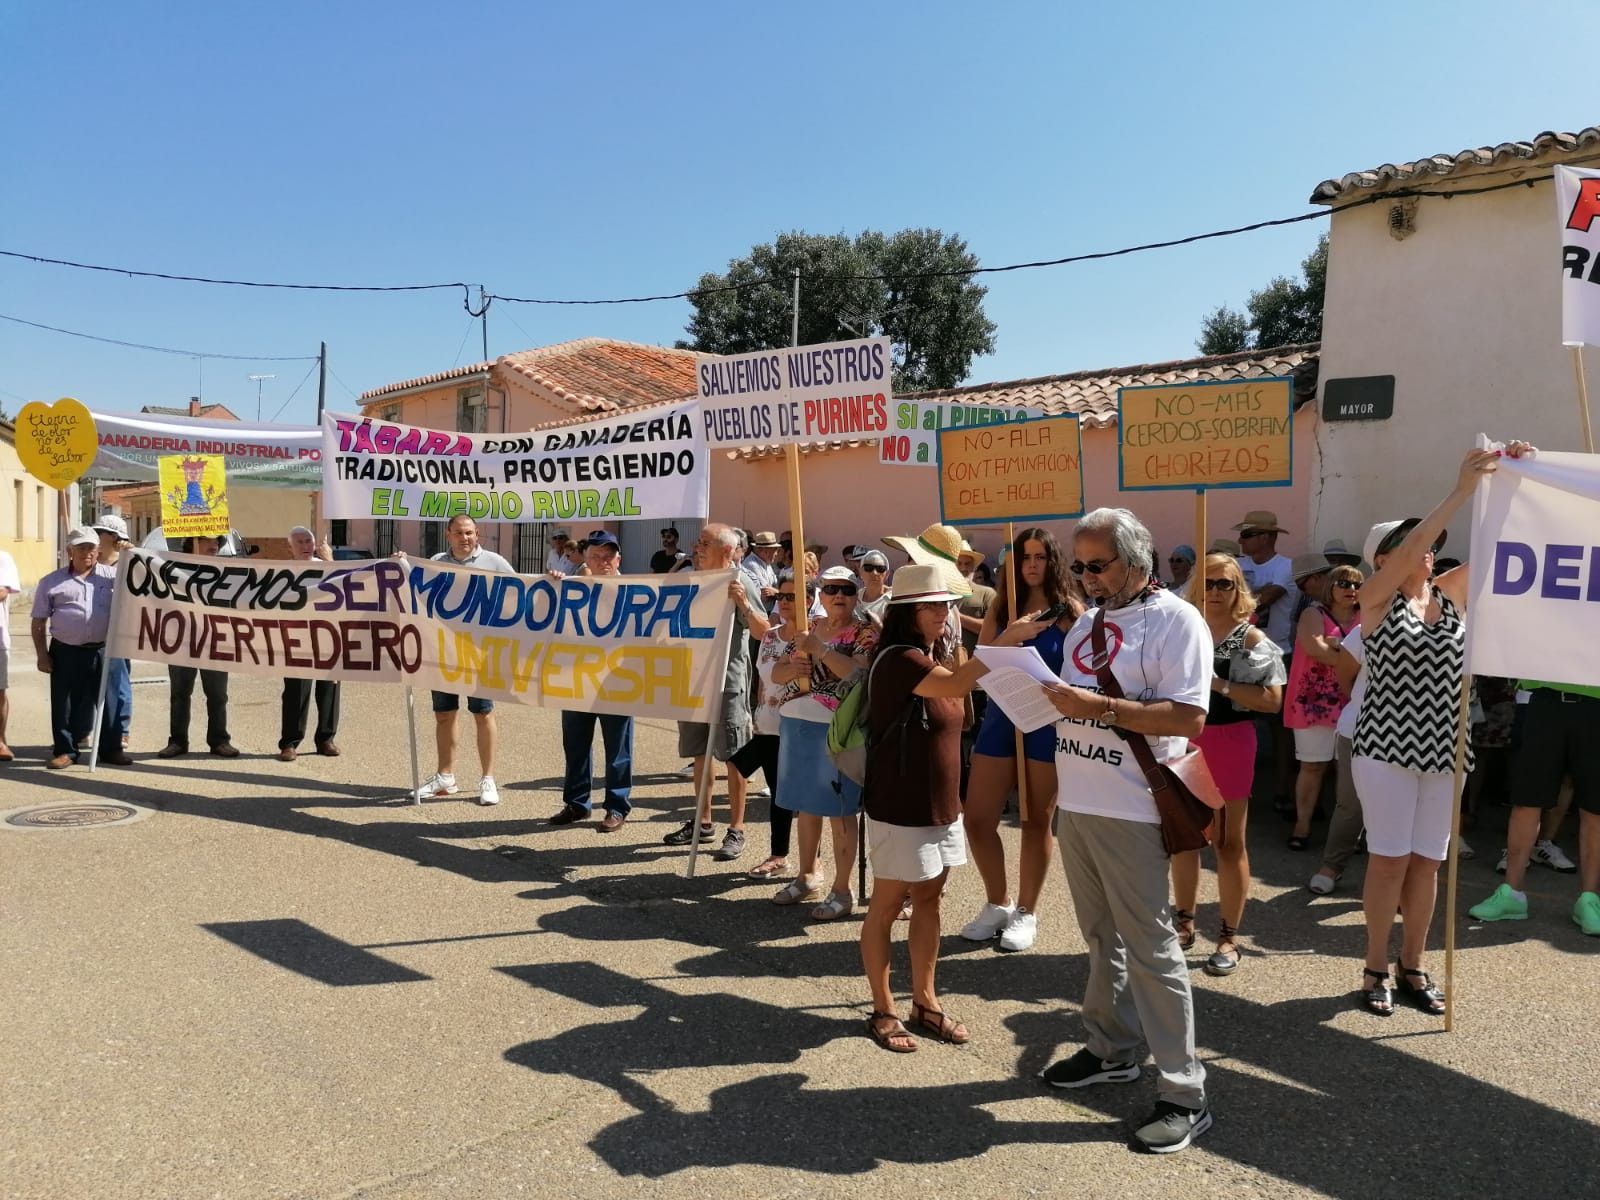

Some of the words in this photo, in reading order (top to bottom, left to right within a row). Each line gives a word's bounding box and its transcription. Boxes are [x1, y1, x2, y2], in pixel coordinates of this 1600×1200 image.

[701, 355, 781, 397] SALVEMOS
[788, 343, 884, 388] NUESTROS
[704, 404, 772, 442] PUEBLOS
[778, 402, 800, 436] DE
[804, 392, 888, 436] PURINES
[897, 403, 918, 430] SI
[1340, 403, 1374, 415] MAYOR
[36, 437, 52, 445] no
[55, 436, 67, 446] es
[336, 418, 473, 456] TÁBARA
[482, 438, 534, 454] CON
[544, 411, 693, 452] GANADERÍA
[39, 445, 53, 455] de
[196, 441, 294, 459] INDUSTRIAL
[298, 447, 323, 462] PO
[882, 435, 911, 462] NO
[917, 442, 929, 462] a
[230, 460, 260, 470] VIVOS
[263, 463, 269, 471] Y
[336, 457, 494, 489] TRADICIONAL,
[504, 449, 694, 483] PROTEGIENDO
[371, 487, 409, 516] EL
[419, 490, 523, 519] MEDIO
[532, 487, 641, 519] RURAL
[126, 553, 324, 610] QUEREMOS
[314, 562, 406, 613] SER
[138, 606, 186, 655] NO
[189, 610, 422, 674] VERTEDERO
[438, 627, 704, 708] UNIVERSAL
